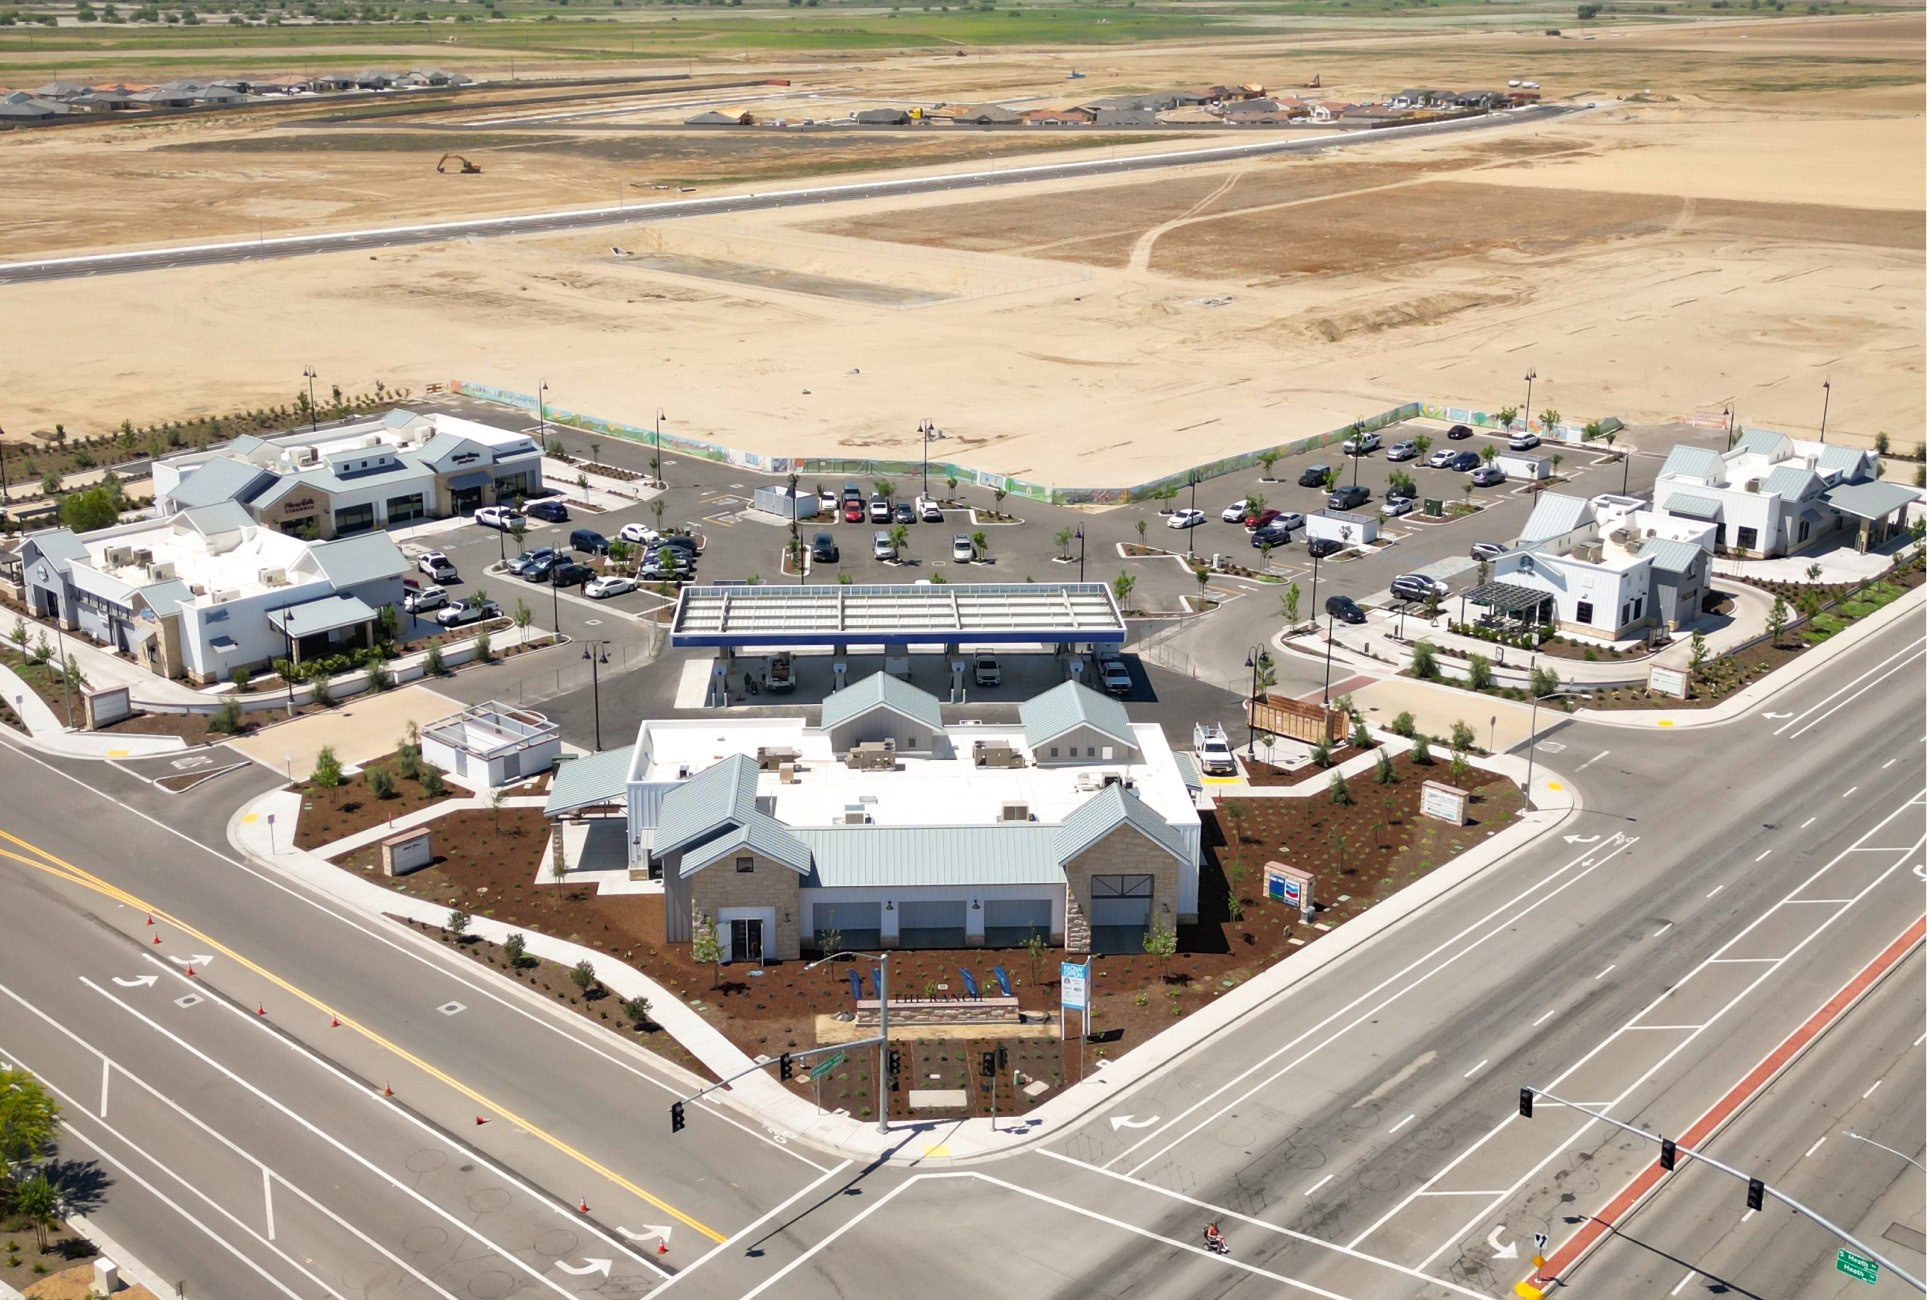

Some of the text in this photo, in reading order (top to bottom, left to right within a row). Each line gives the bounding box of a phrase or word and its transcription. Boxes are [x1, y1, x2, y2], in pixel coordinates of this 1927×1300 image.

[1063, 970, 1083, 978] OPEN
[895, 993, 984, 1003] THE RANCH
[1848, 1254, 1869, 1268] Heath
[1843, 1264, 1864, 1277] Heath
